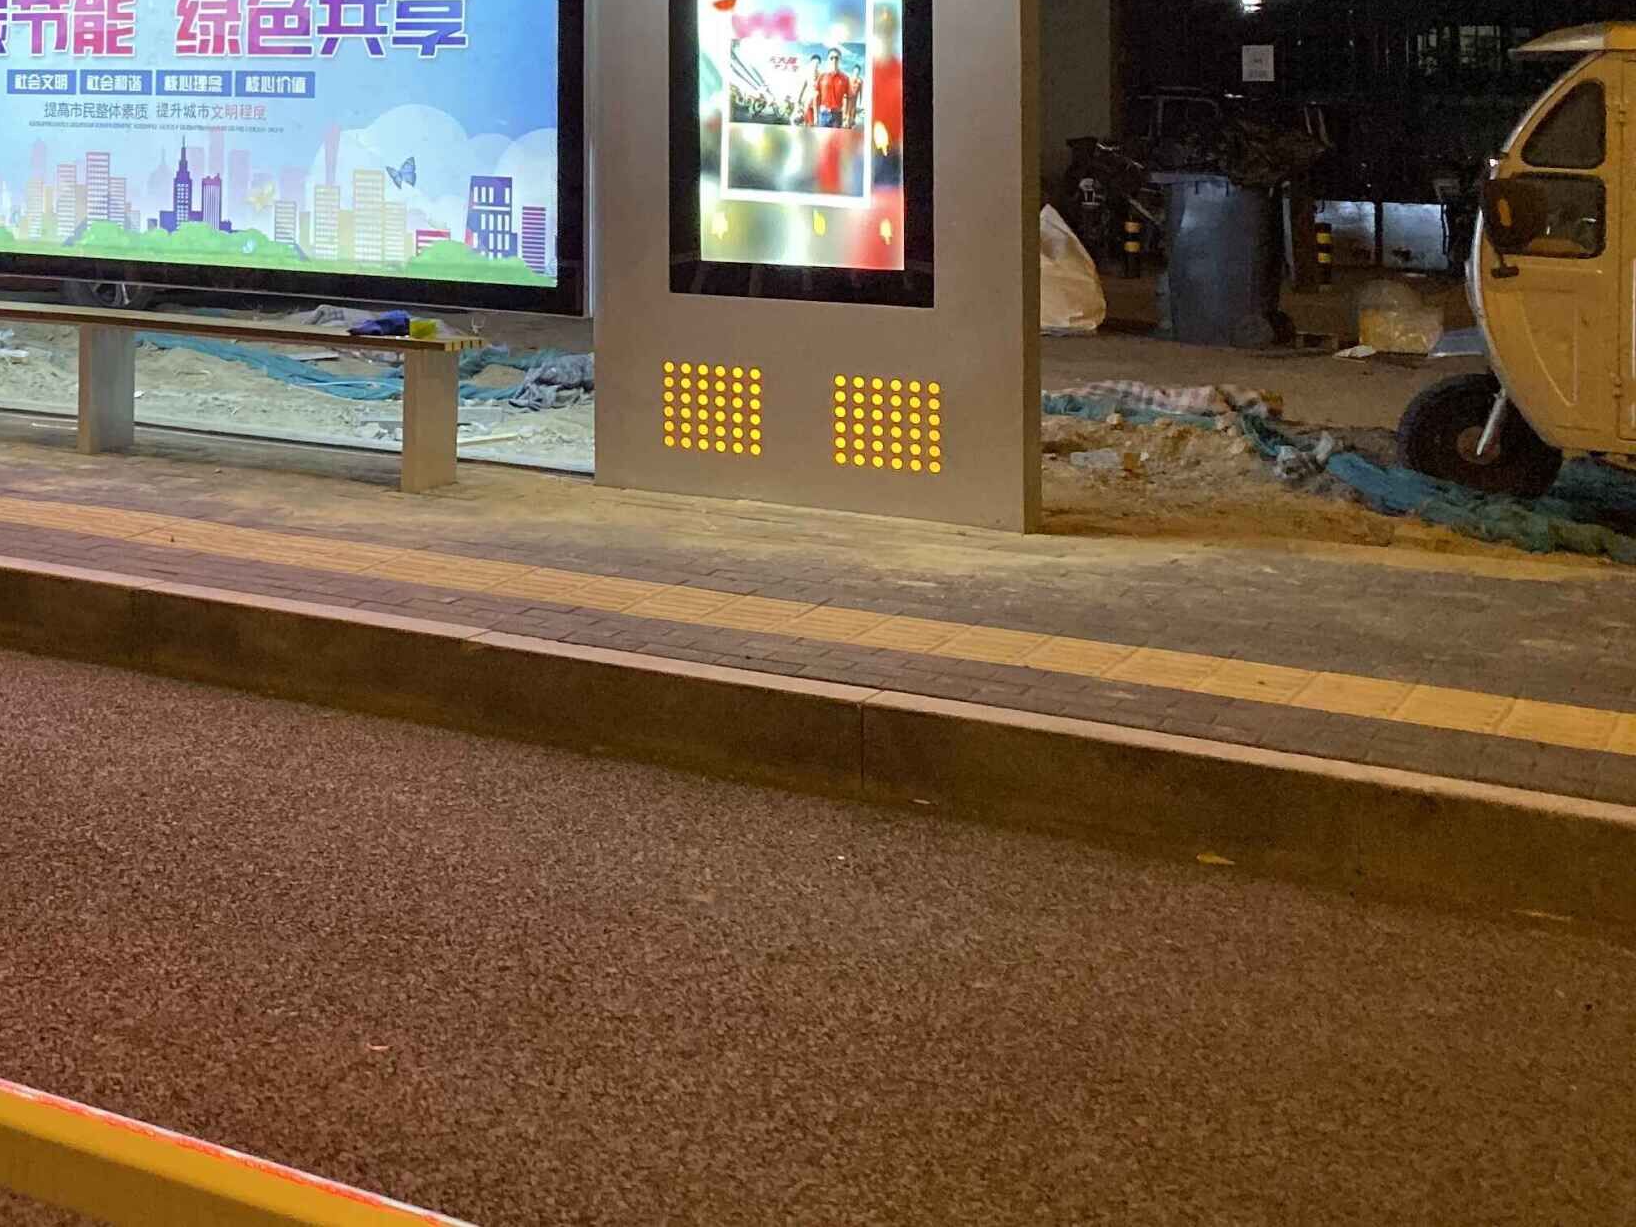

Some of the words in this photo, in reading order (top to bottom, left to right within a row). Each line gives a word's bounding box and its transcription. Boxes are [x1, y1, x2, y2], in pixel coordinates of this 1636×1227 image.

[14, 73, 69, 91] 社会文明
[44, 101, 149, 120] 提高市民整体素质
